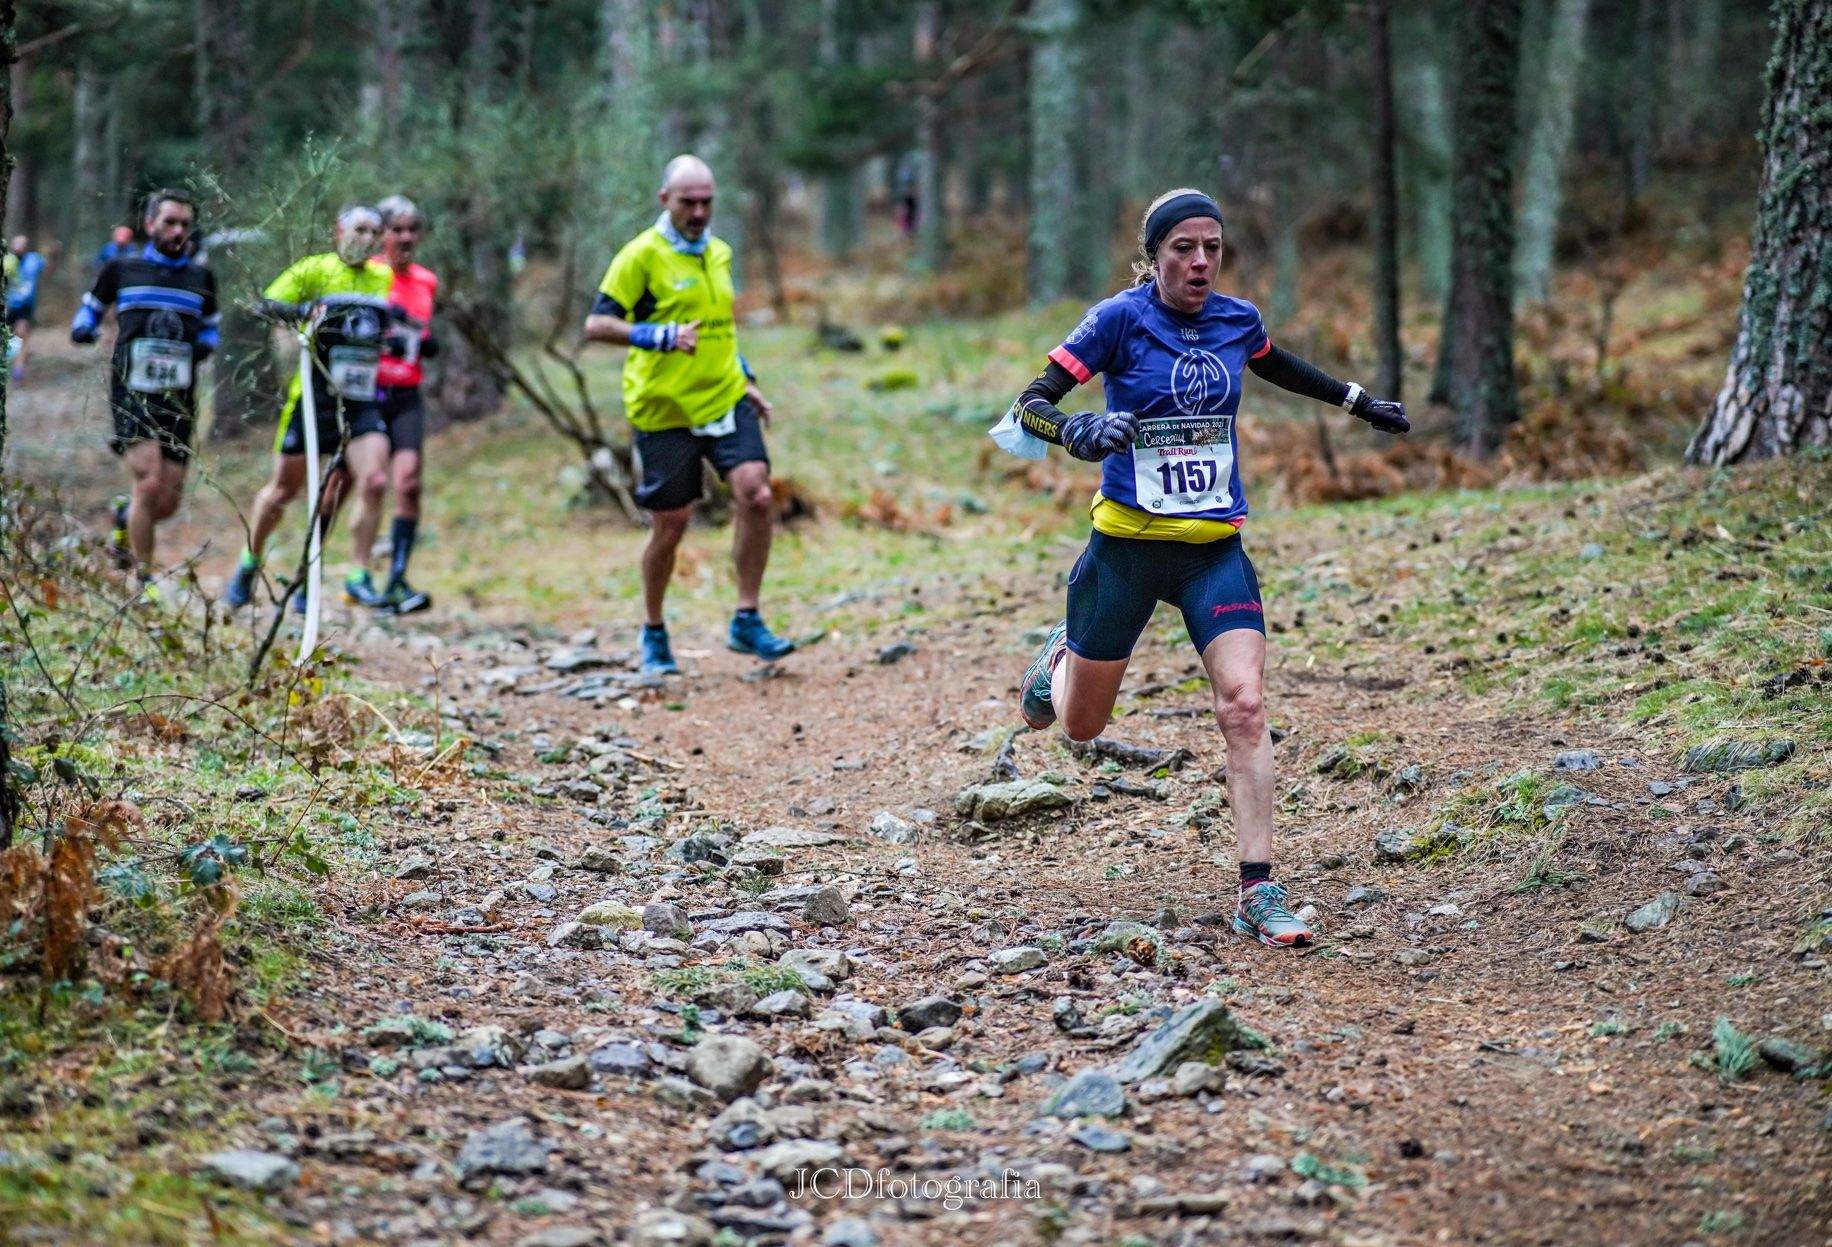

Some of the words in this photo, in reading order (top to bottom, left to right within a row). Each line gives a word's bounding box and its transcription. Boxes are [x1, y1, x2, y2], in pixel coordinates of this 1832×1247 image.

[1181, 422, 1210, 430] NAVIDAD
[1157, 448, 1177, 456] Trail
[1177, 447, 1198, 456] Run
[1156, 460, 1217, 495] 1157
